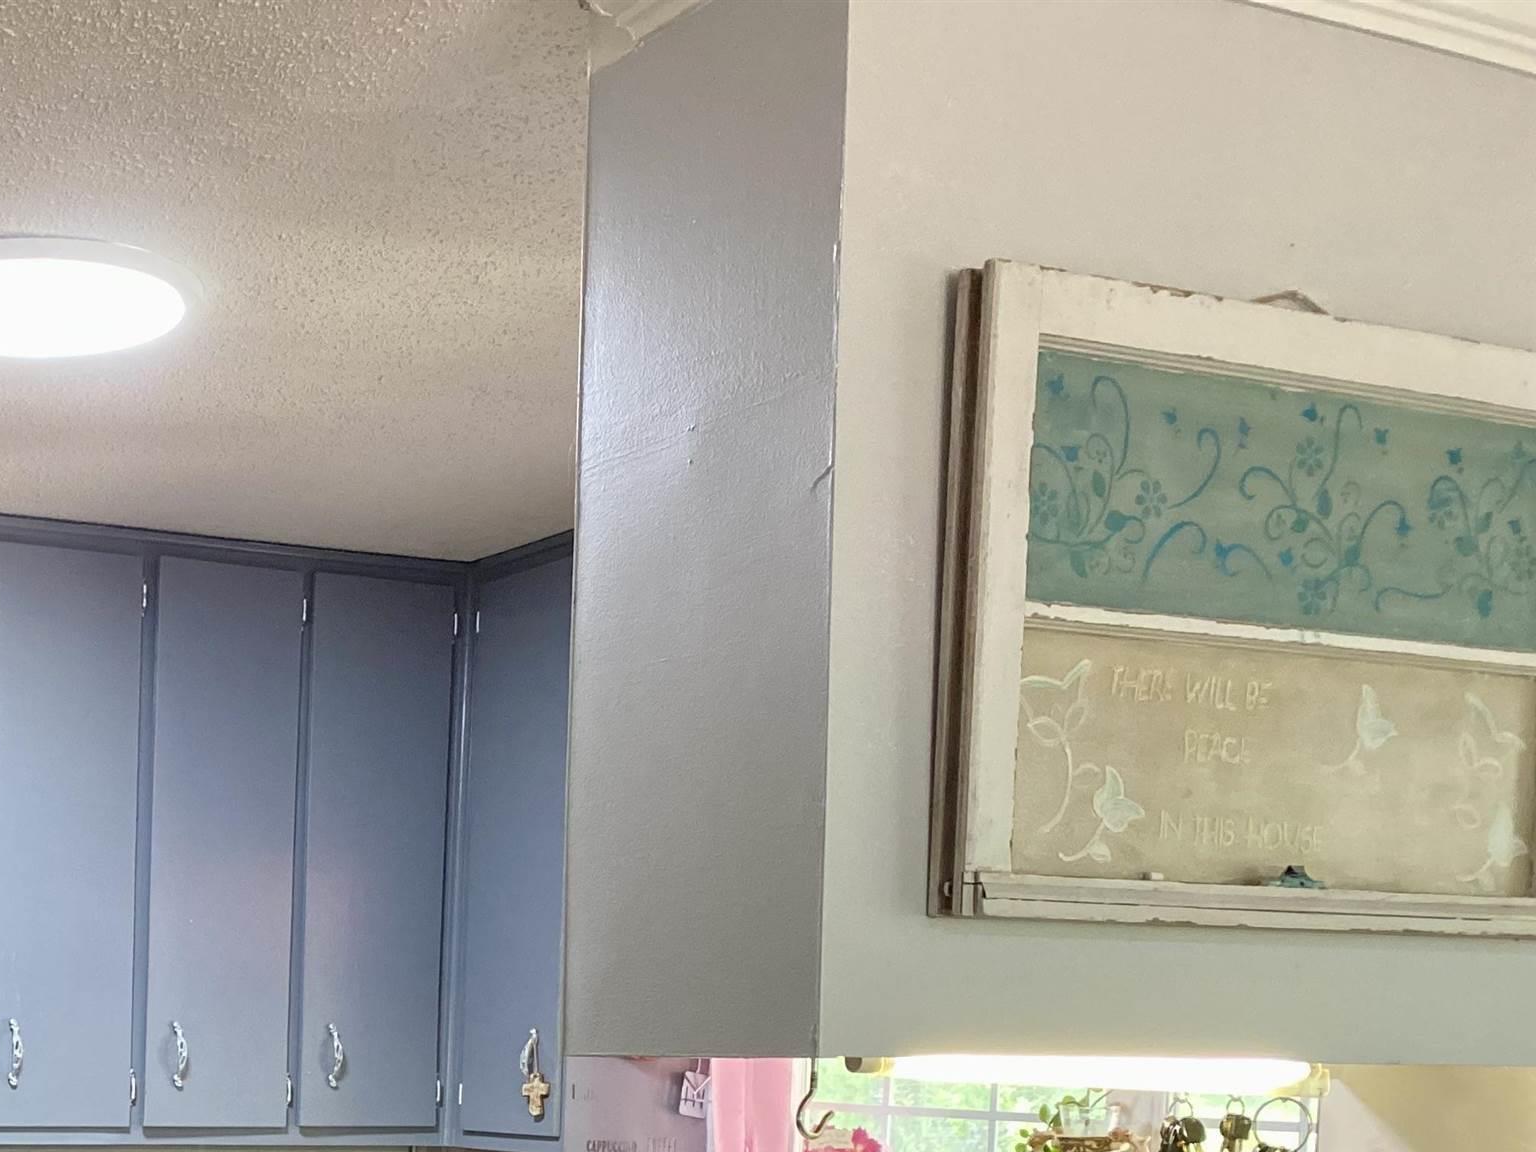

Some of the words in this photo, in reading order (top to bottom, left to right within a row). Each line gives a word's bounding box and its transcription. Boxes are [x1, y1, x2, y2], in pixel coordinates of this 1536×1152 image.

[1185, 672, 1237, 711] WILL
[1246, 681, 1273, 711] BE
[1183, 729, 1251, 765] PEACE
[1159, 809, 1183, 841] IN
[1192, 816, 1235, 847] THIS
[1245, 816, 1324, 853] HOUSE
